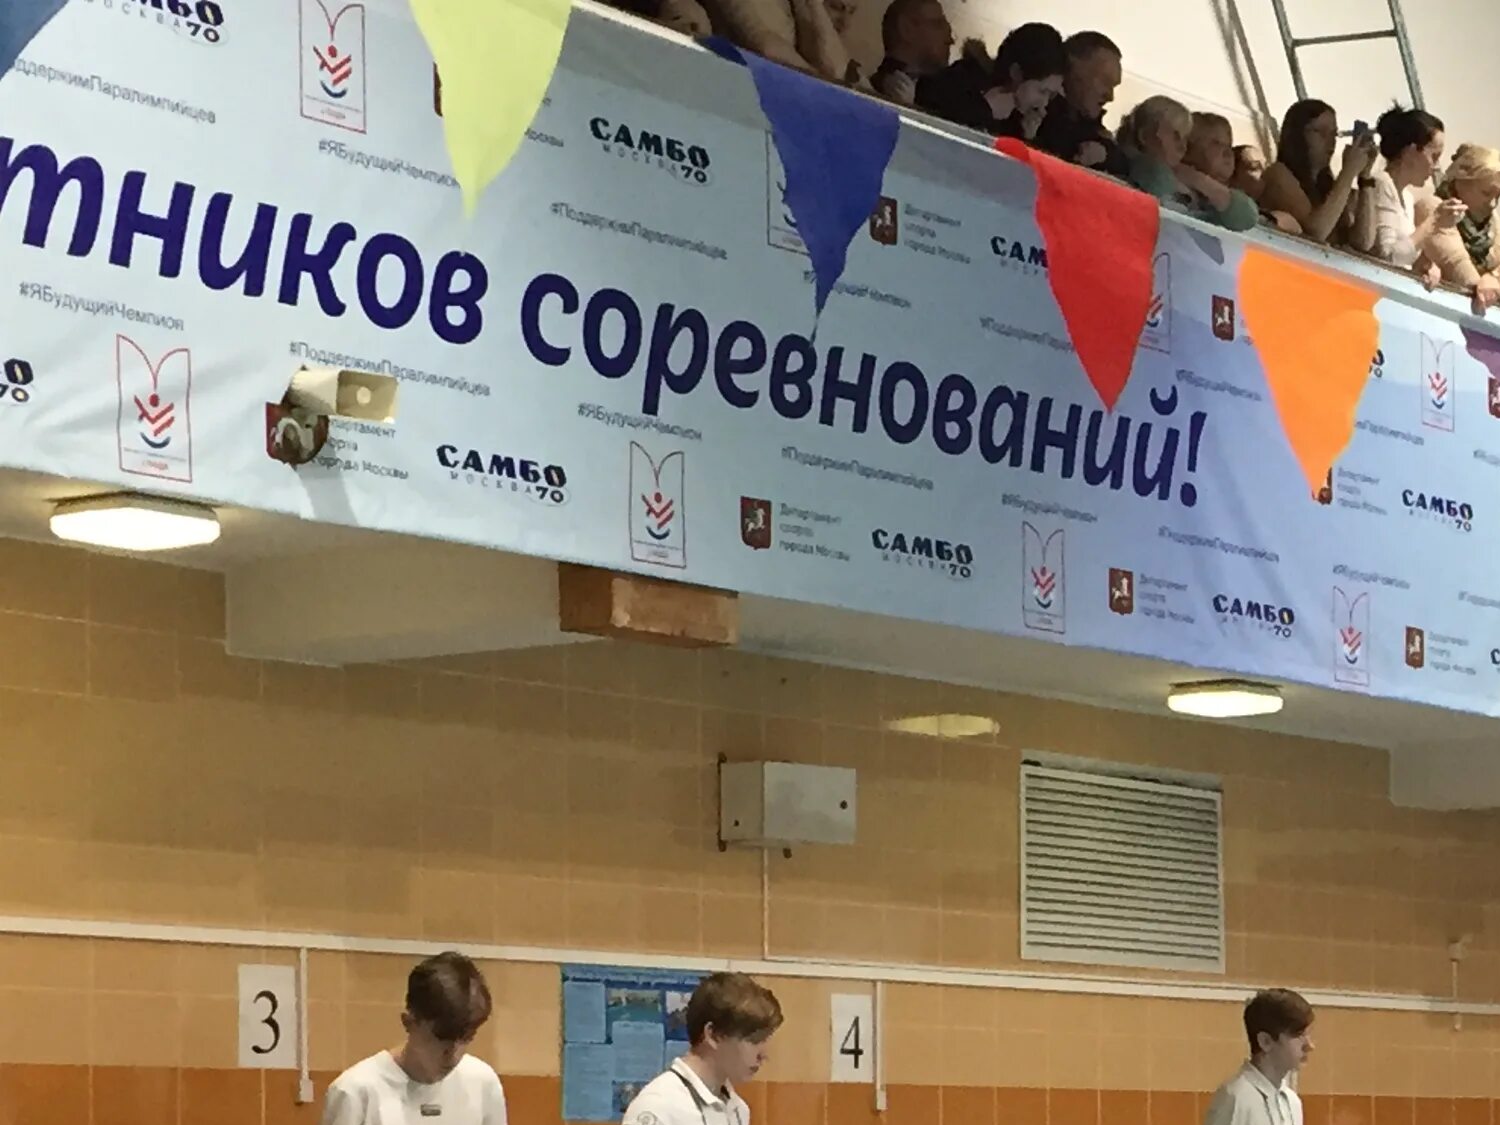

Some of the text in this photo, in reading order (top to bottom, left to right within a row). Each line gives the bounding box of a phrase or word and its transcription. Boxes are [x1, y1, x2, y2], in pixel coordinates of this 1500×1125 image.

[187, 21, 220, 43] 70
[15, 57, 216, 124] ддержимПаралимпийцев
[590, 116, 711, 170] САМБО
[681, 165, 708, 183] 70
[989, 236, 1049, 268] САМ
[0, 136, 1207, 508] тников соревнований!
[19, 281, 184, 331] #ЯБудущийЧемпион
[436, 444, 567, 487] САМБО
[535, 485, 566, 503] 70
[1402, 489, 1473, 520] САМБО
[872, 529, 973, 564] САМБО
[950, 563, 972, 578] 70
[1213, 594, 1294, 625] САМБО
[1274, 624, 1291, 638] 70
[251, 990, 281, 1054] 3
[840, 1015, 864, 1069] 4
